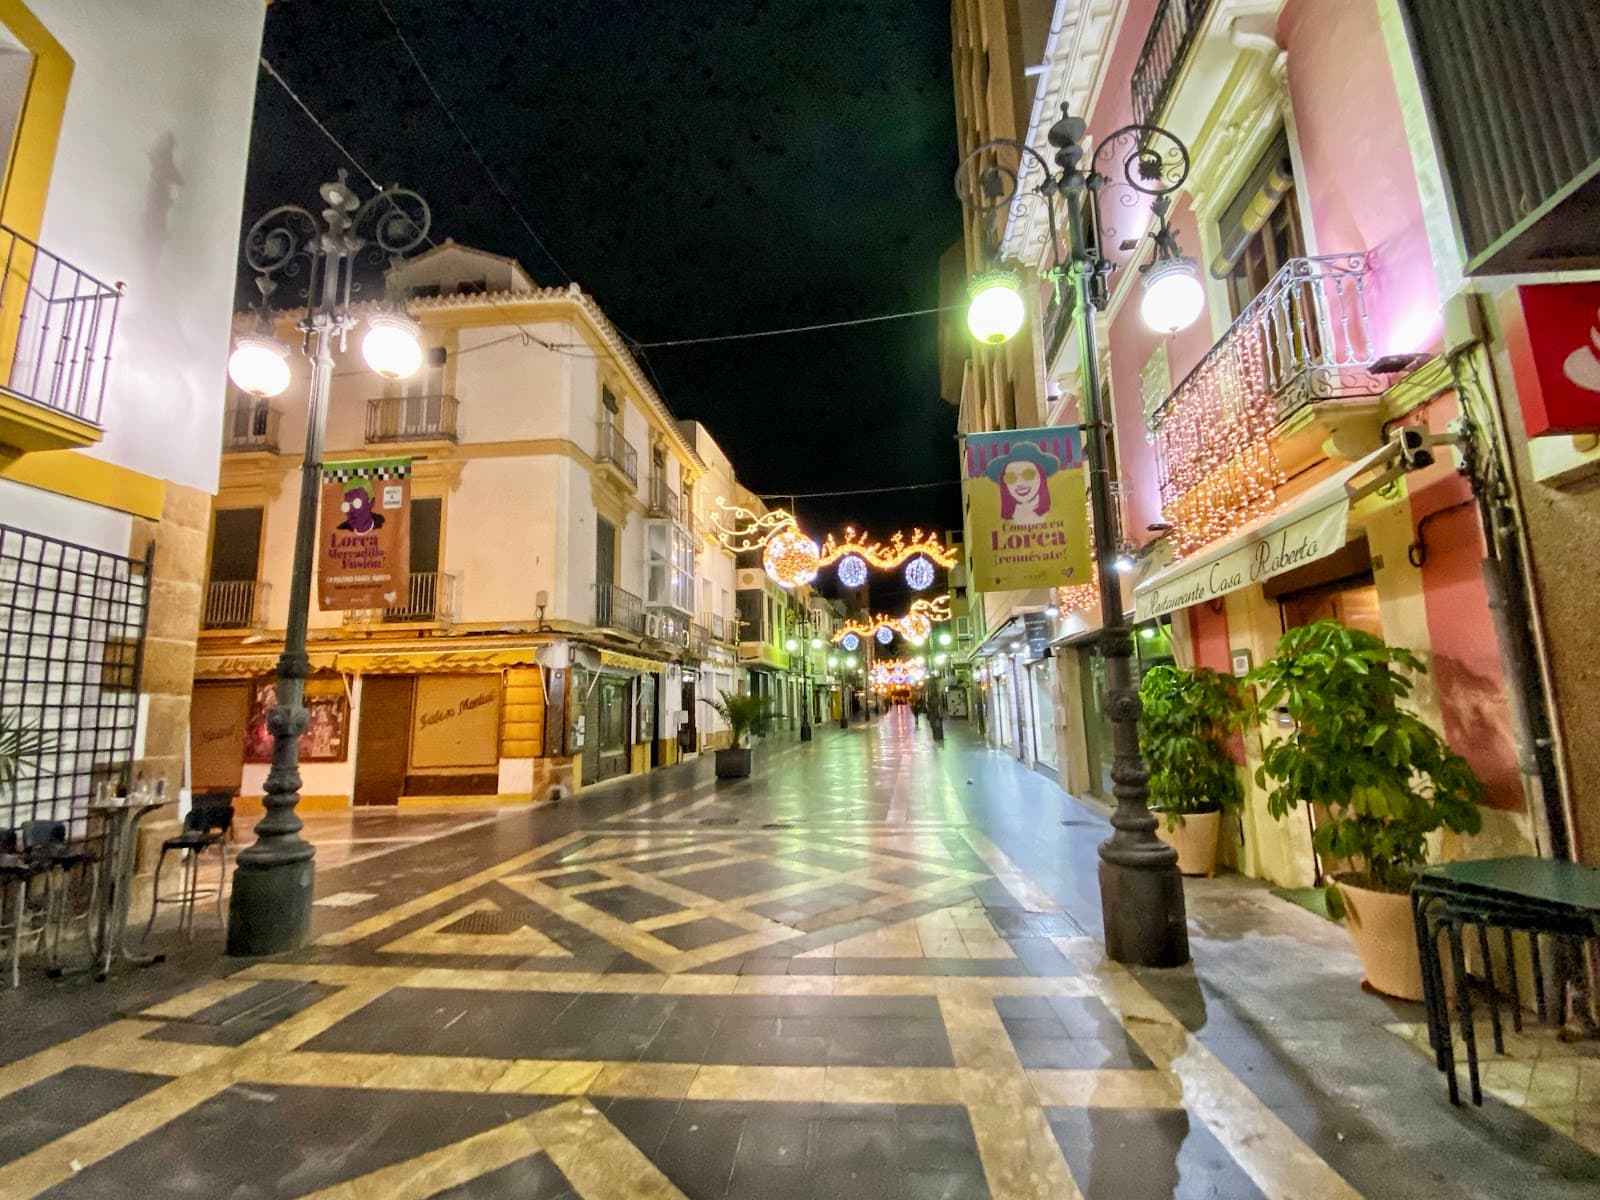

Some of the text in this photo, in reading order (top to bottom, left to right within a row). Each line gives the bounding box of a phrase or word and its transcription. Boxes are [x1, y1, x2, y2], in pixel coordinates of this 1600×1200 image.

[330, 533, 378, 548] Lorca
[991, 530, 1066, 551] Lorca
[1144, 530, 1319, 618] Restaurante Casa Roberto
